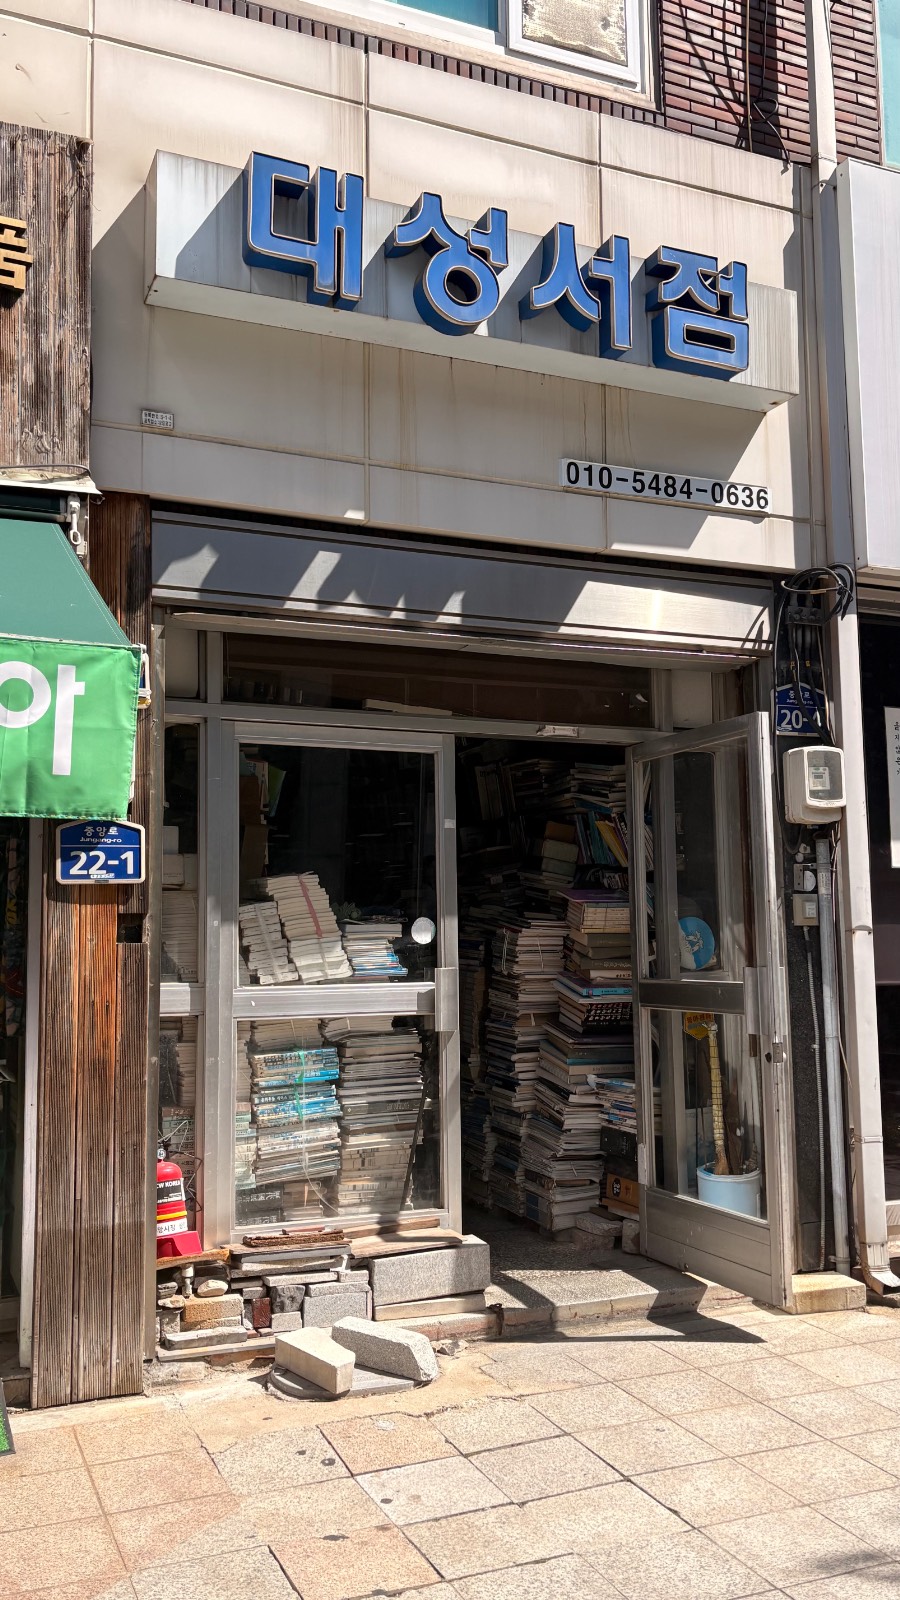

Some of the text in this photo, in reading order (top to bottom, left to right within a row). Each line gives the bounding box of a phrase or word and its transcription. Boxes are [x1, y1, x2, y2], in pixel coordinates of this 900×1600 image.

[246, 152, 749, 375] 대성서점
[566, 461, 769, 510] 010-5484-0636
[789, 690, 811, 699] 중로
[84, 826, 119, 837] 중앙로
[69, 850, 134, 875] 22-1
